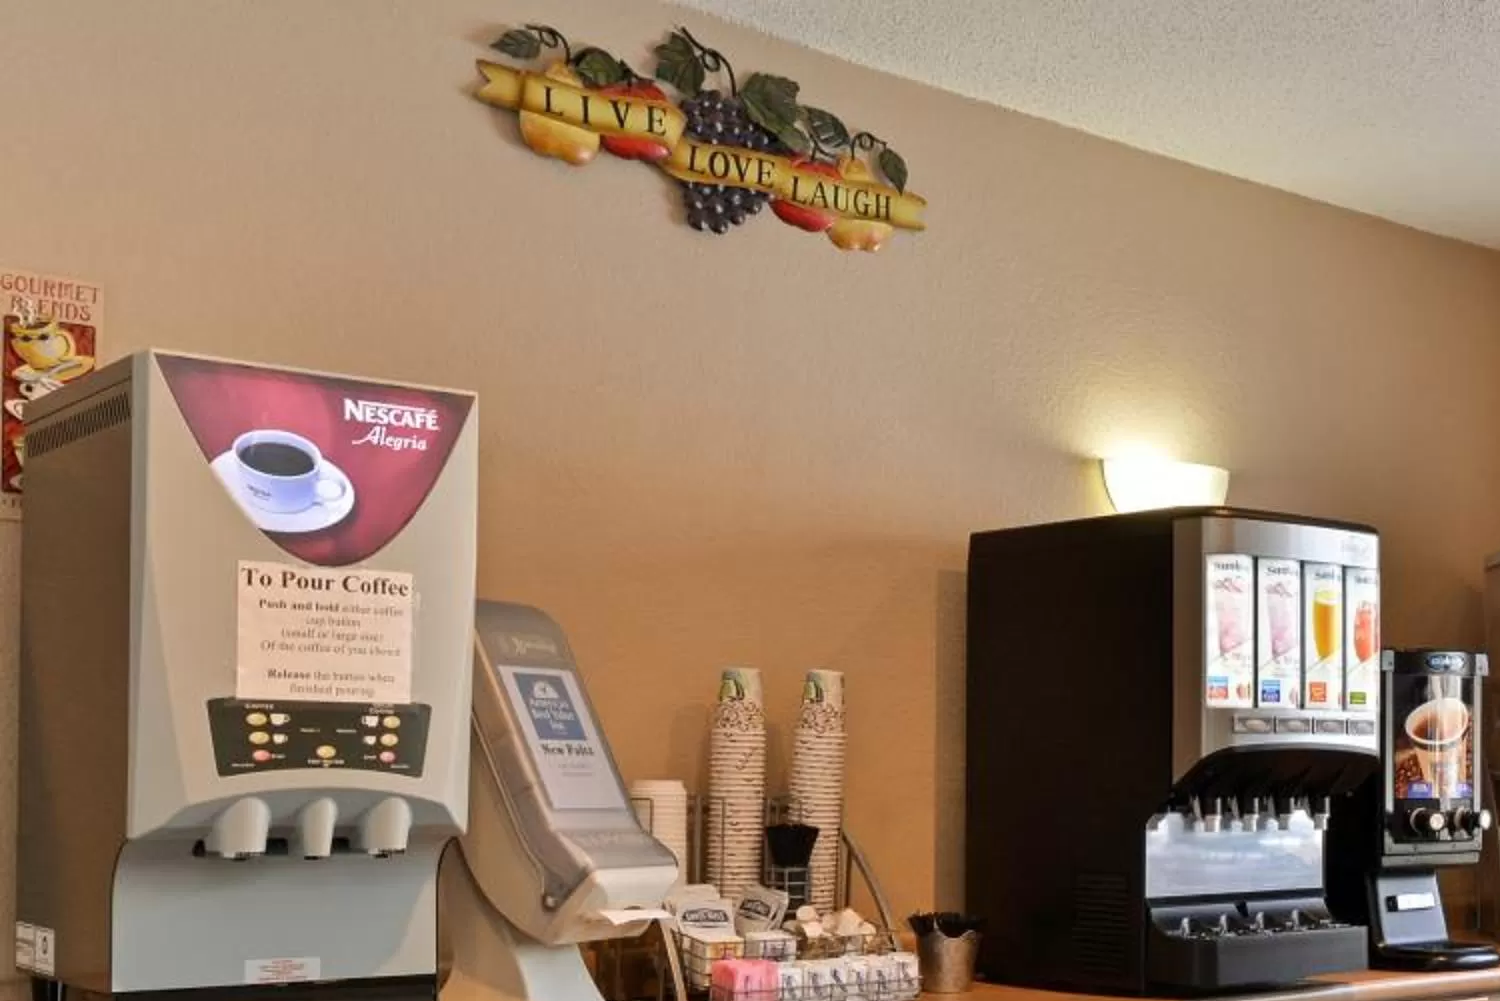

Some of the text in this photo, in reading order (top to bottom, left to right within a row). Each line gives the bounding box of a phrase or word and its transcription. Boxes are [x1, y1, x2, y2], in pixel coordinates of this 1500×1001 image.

[544, 86, 668, 138] LIVE
[687, 145, 893, 220] LOVE LAUGH
[1, 273, 100, 304] GOURMET
[11, 296, 91, 321] BENDS
[343, 398, 440, 431] NESCAFÉ
[352, 426, 428, 451] Alegria
[240, 567, 410, 597] To Pour Coffee
[259, 599, 288, 610] Push
[291, 601, 313, 611] and
[315, 602, 340, 613] hold
[267, 668, 311, 680] Release
